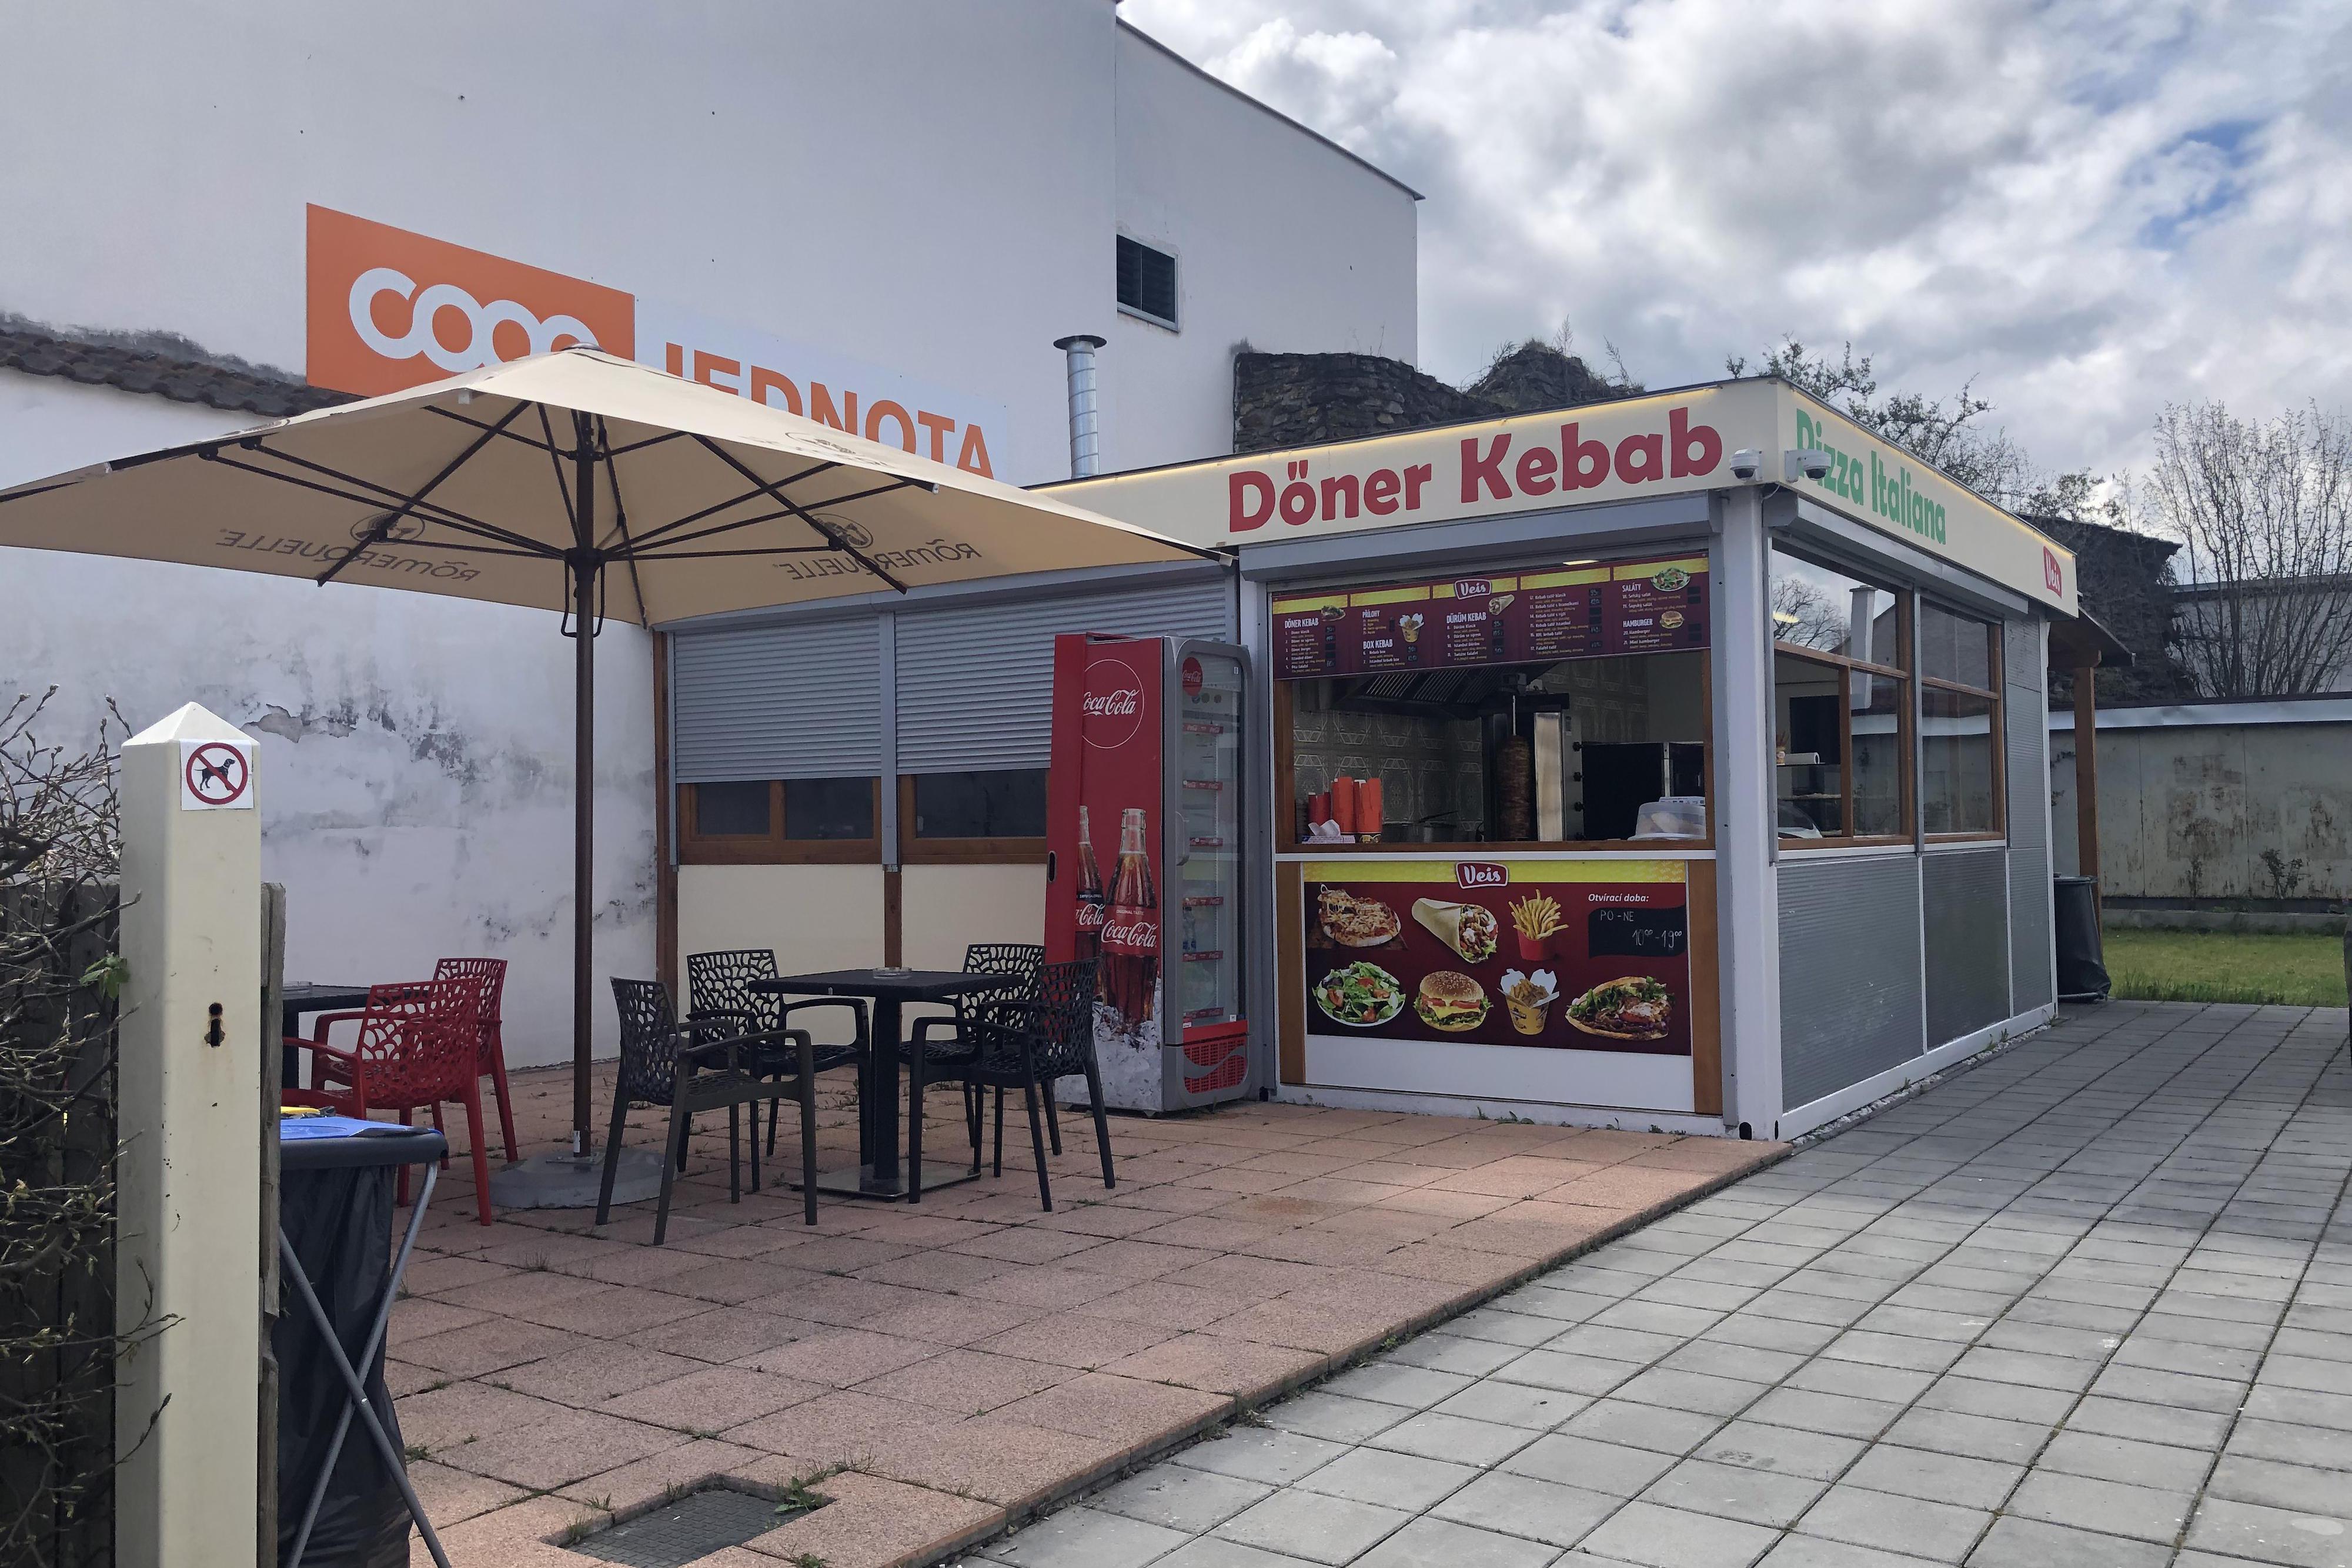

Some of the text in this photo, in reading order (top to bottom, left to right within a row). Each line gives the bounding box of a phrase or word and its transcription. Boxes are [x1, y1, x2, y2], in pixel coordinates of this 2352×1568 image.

[1229, 406, 1723, 533] Döner Kebab
[1871, 450, 1946, 545] Italiana
[2046, 553, 2060, 592] Veis
[1460, 582, 1486, 596] Veis
[1622, 582, 1642, 592] SALÁTY
[1362, 609, 1380, 618] PŘÍLOHY
[1446, 612, 1486, 623] DÜRÜM KEBAB
[1285, 618, 1318, 628] DÖNER KEBAB
[1623, 618, 1653, 627] HAMBURGER
[1363, 639, 1393, 649] BOX KEBAB
[1464, 865, 1501, 884] Veis
[1588, 893, 1649, 902] Otvírací doba:
[1600, 910, 1613, 921] PO
[1101, 920, 1158, 948] Coca-Cola
